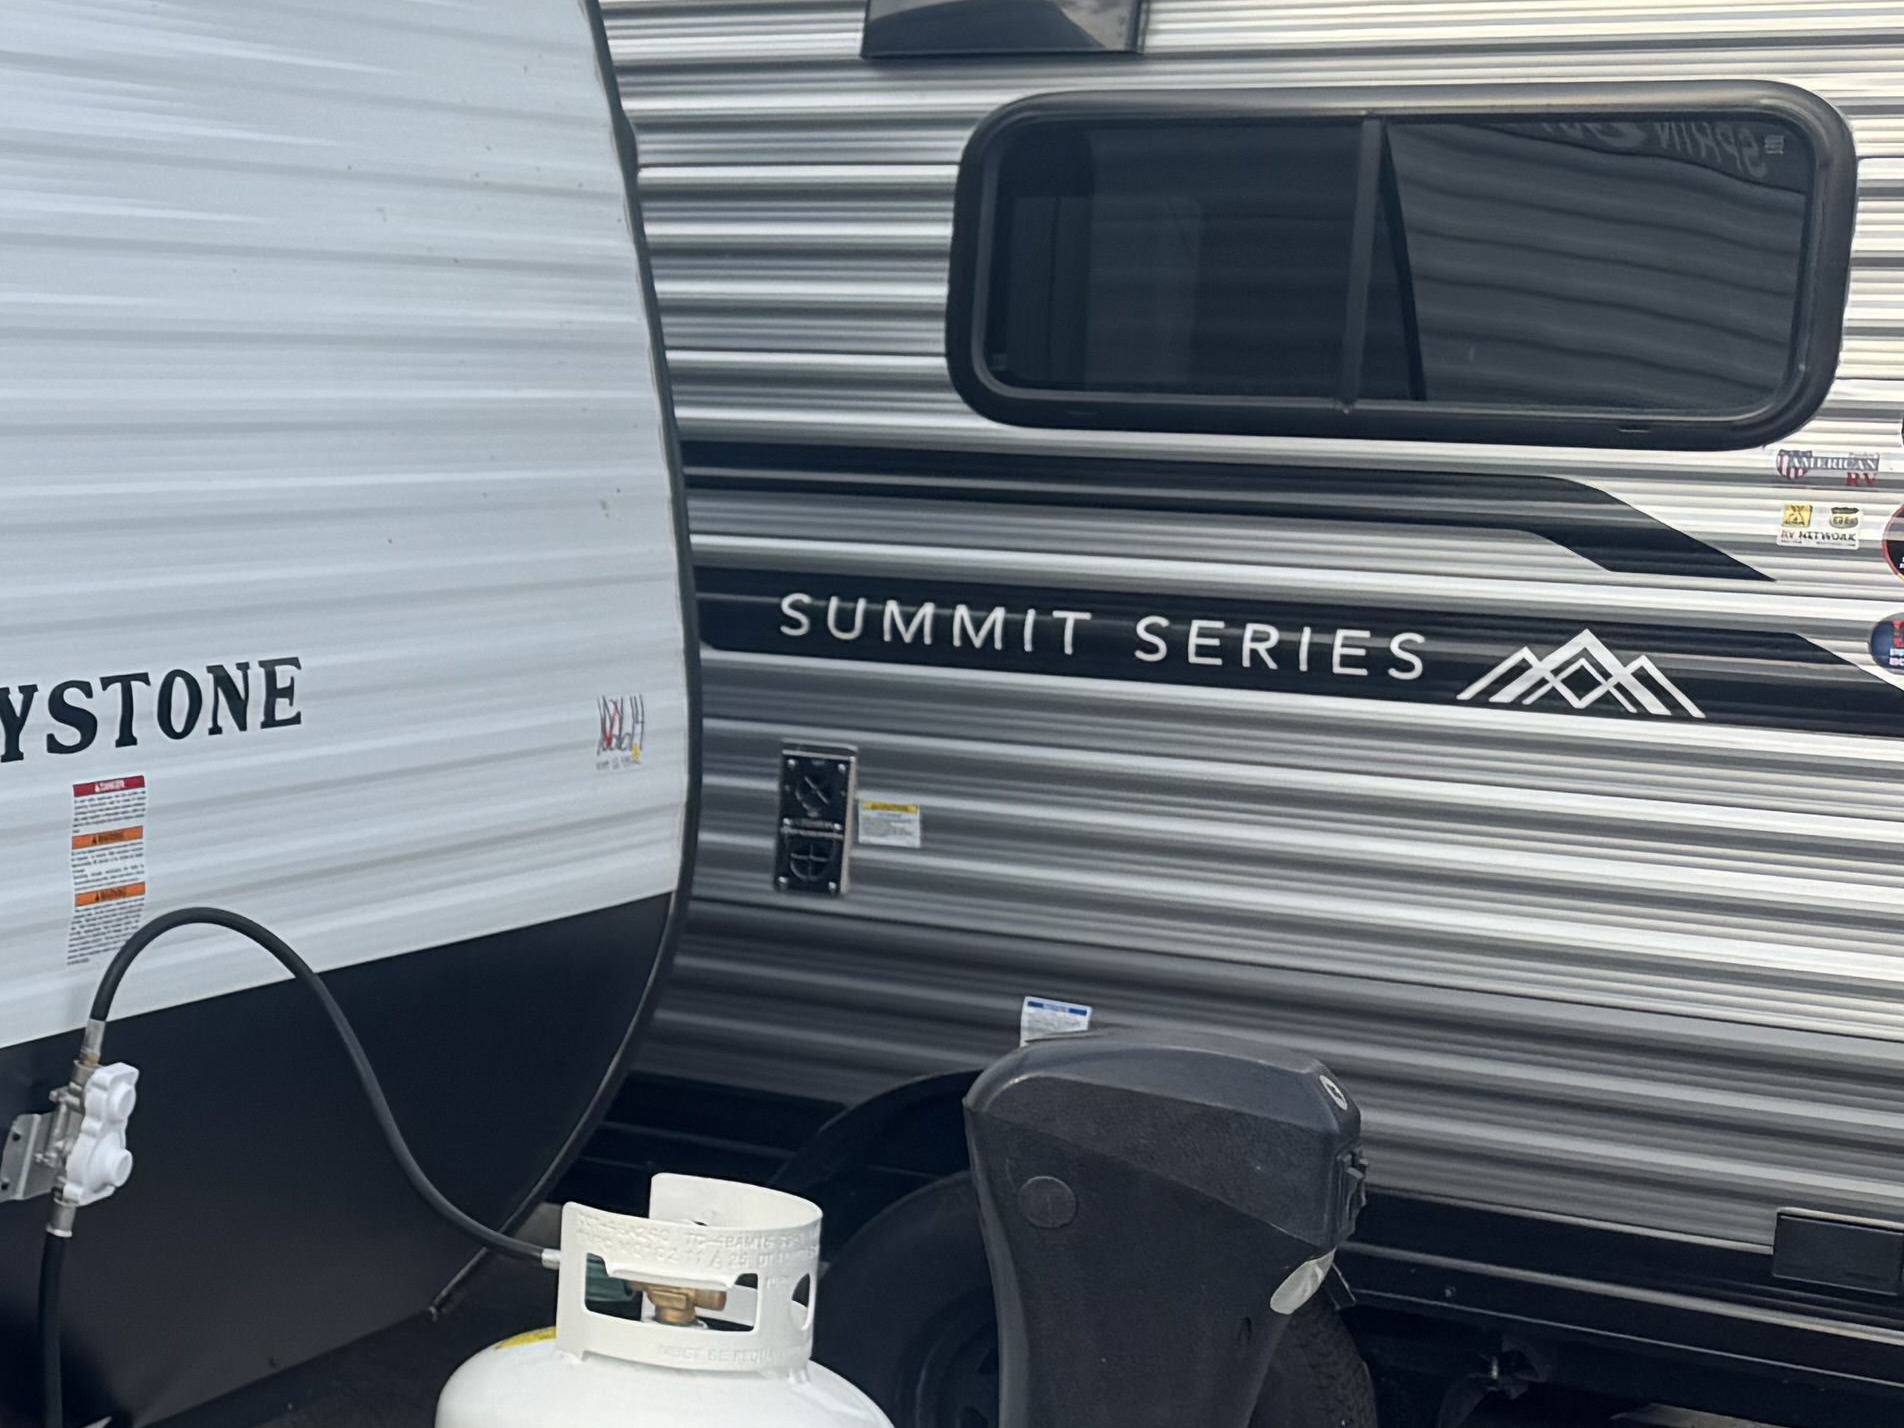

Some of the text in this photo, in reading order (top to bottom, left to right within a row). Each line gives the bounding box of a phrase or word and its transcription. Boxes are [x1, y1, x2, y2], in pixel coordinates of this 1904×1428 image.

[1792, 456, 1877, 471] AMERICAN
[1847, 472, 1878, 487] RV
[1798, 531, 1857, 541] NETWORK
[779, 591, 1428, 681] SUMMIT SERIES
